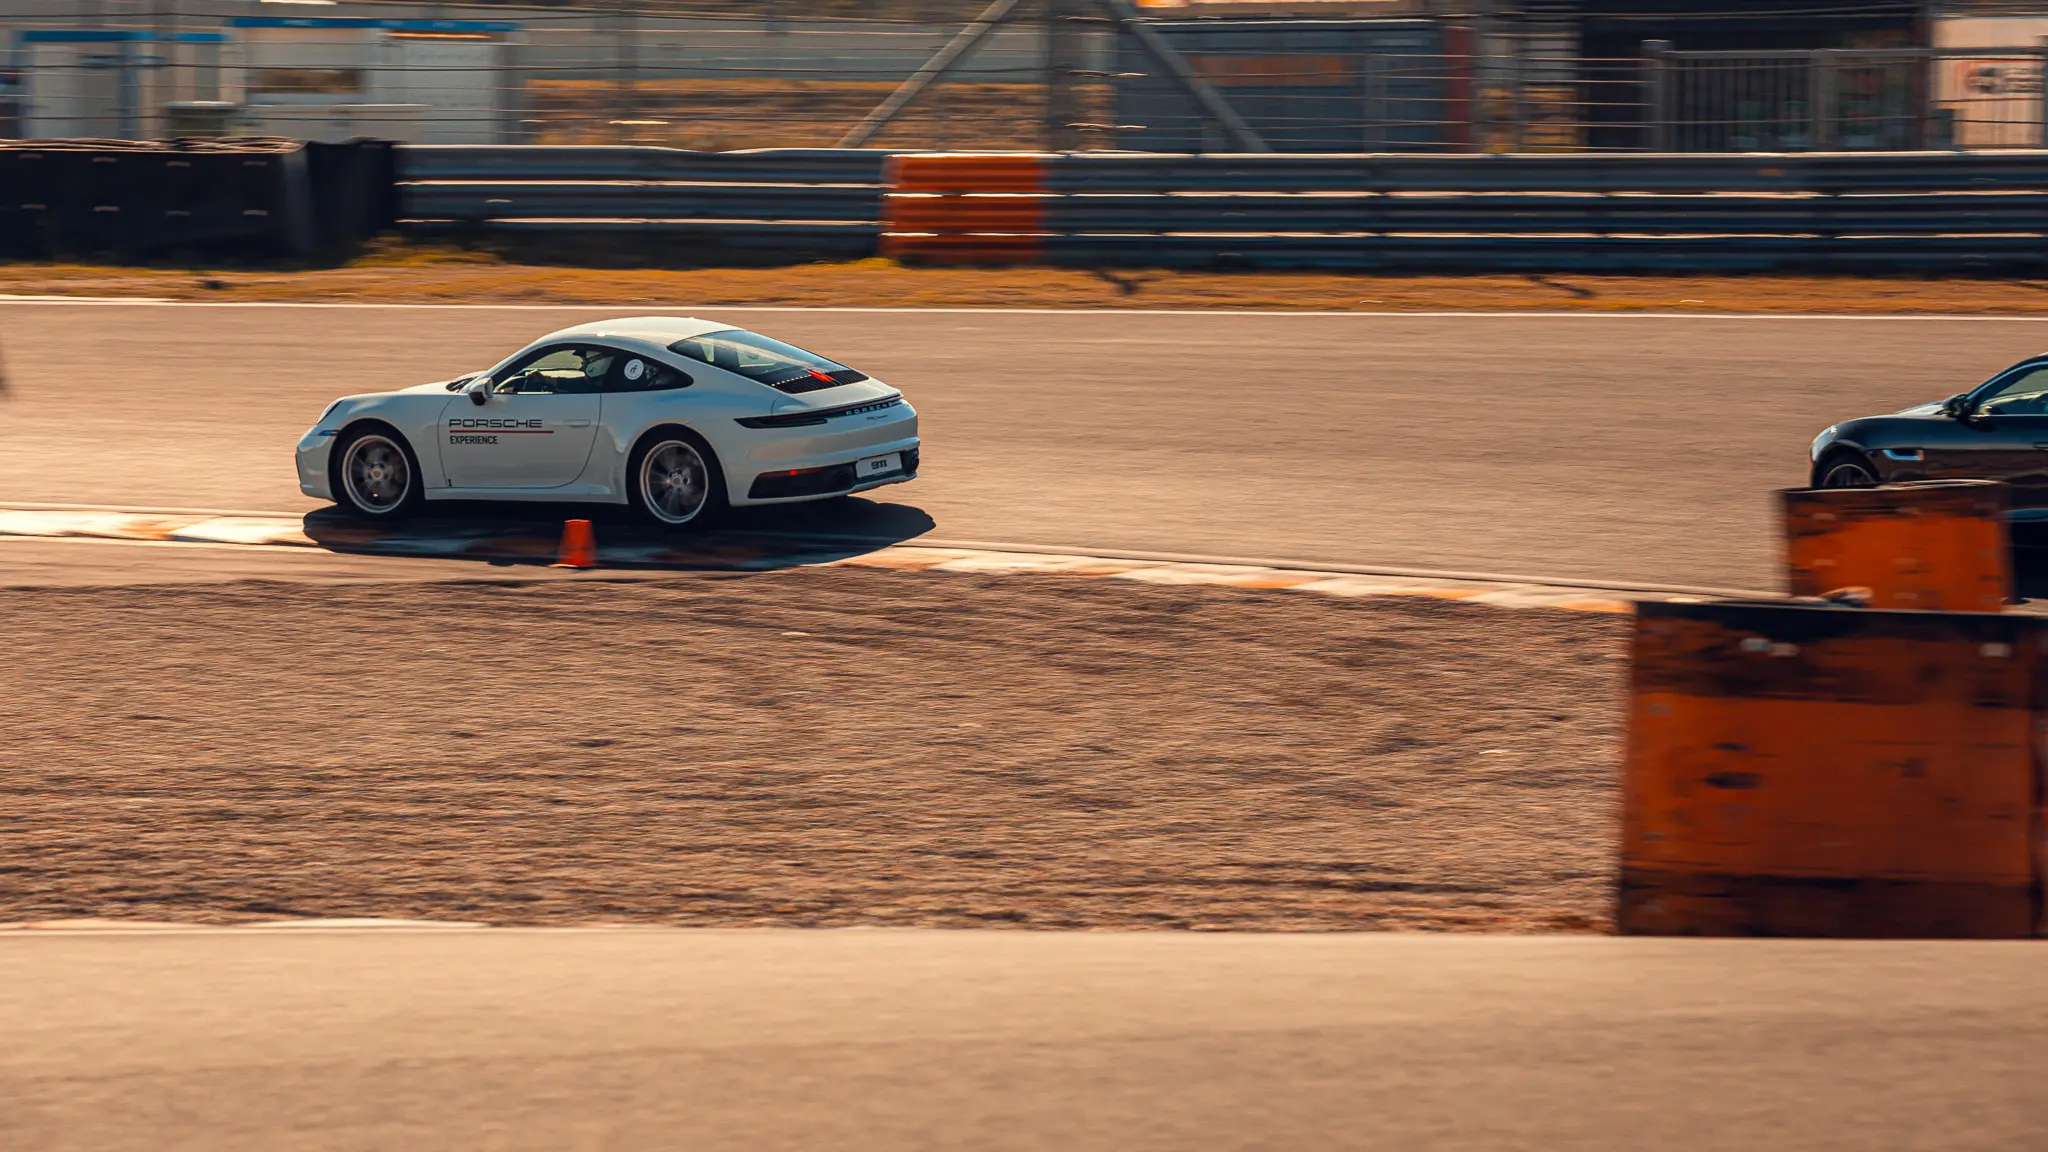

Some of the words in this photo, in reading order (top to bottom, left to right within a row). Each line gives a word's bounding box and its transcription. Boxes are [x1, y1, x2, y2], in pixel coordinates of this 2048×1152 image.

[845, 402, 893, 416] PORSCHE
[448, 418, 543, 428] PORSCHE
[449, 435, 498, 445] EXPERIENCE
[870, 459, 888, 470] 911
